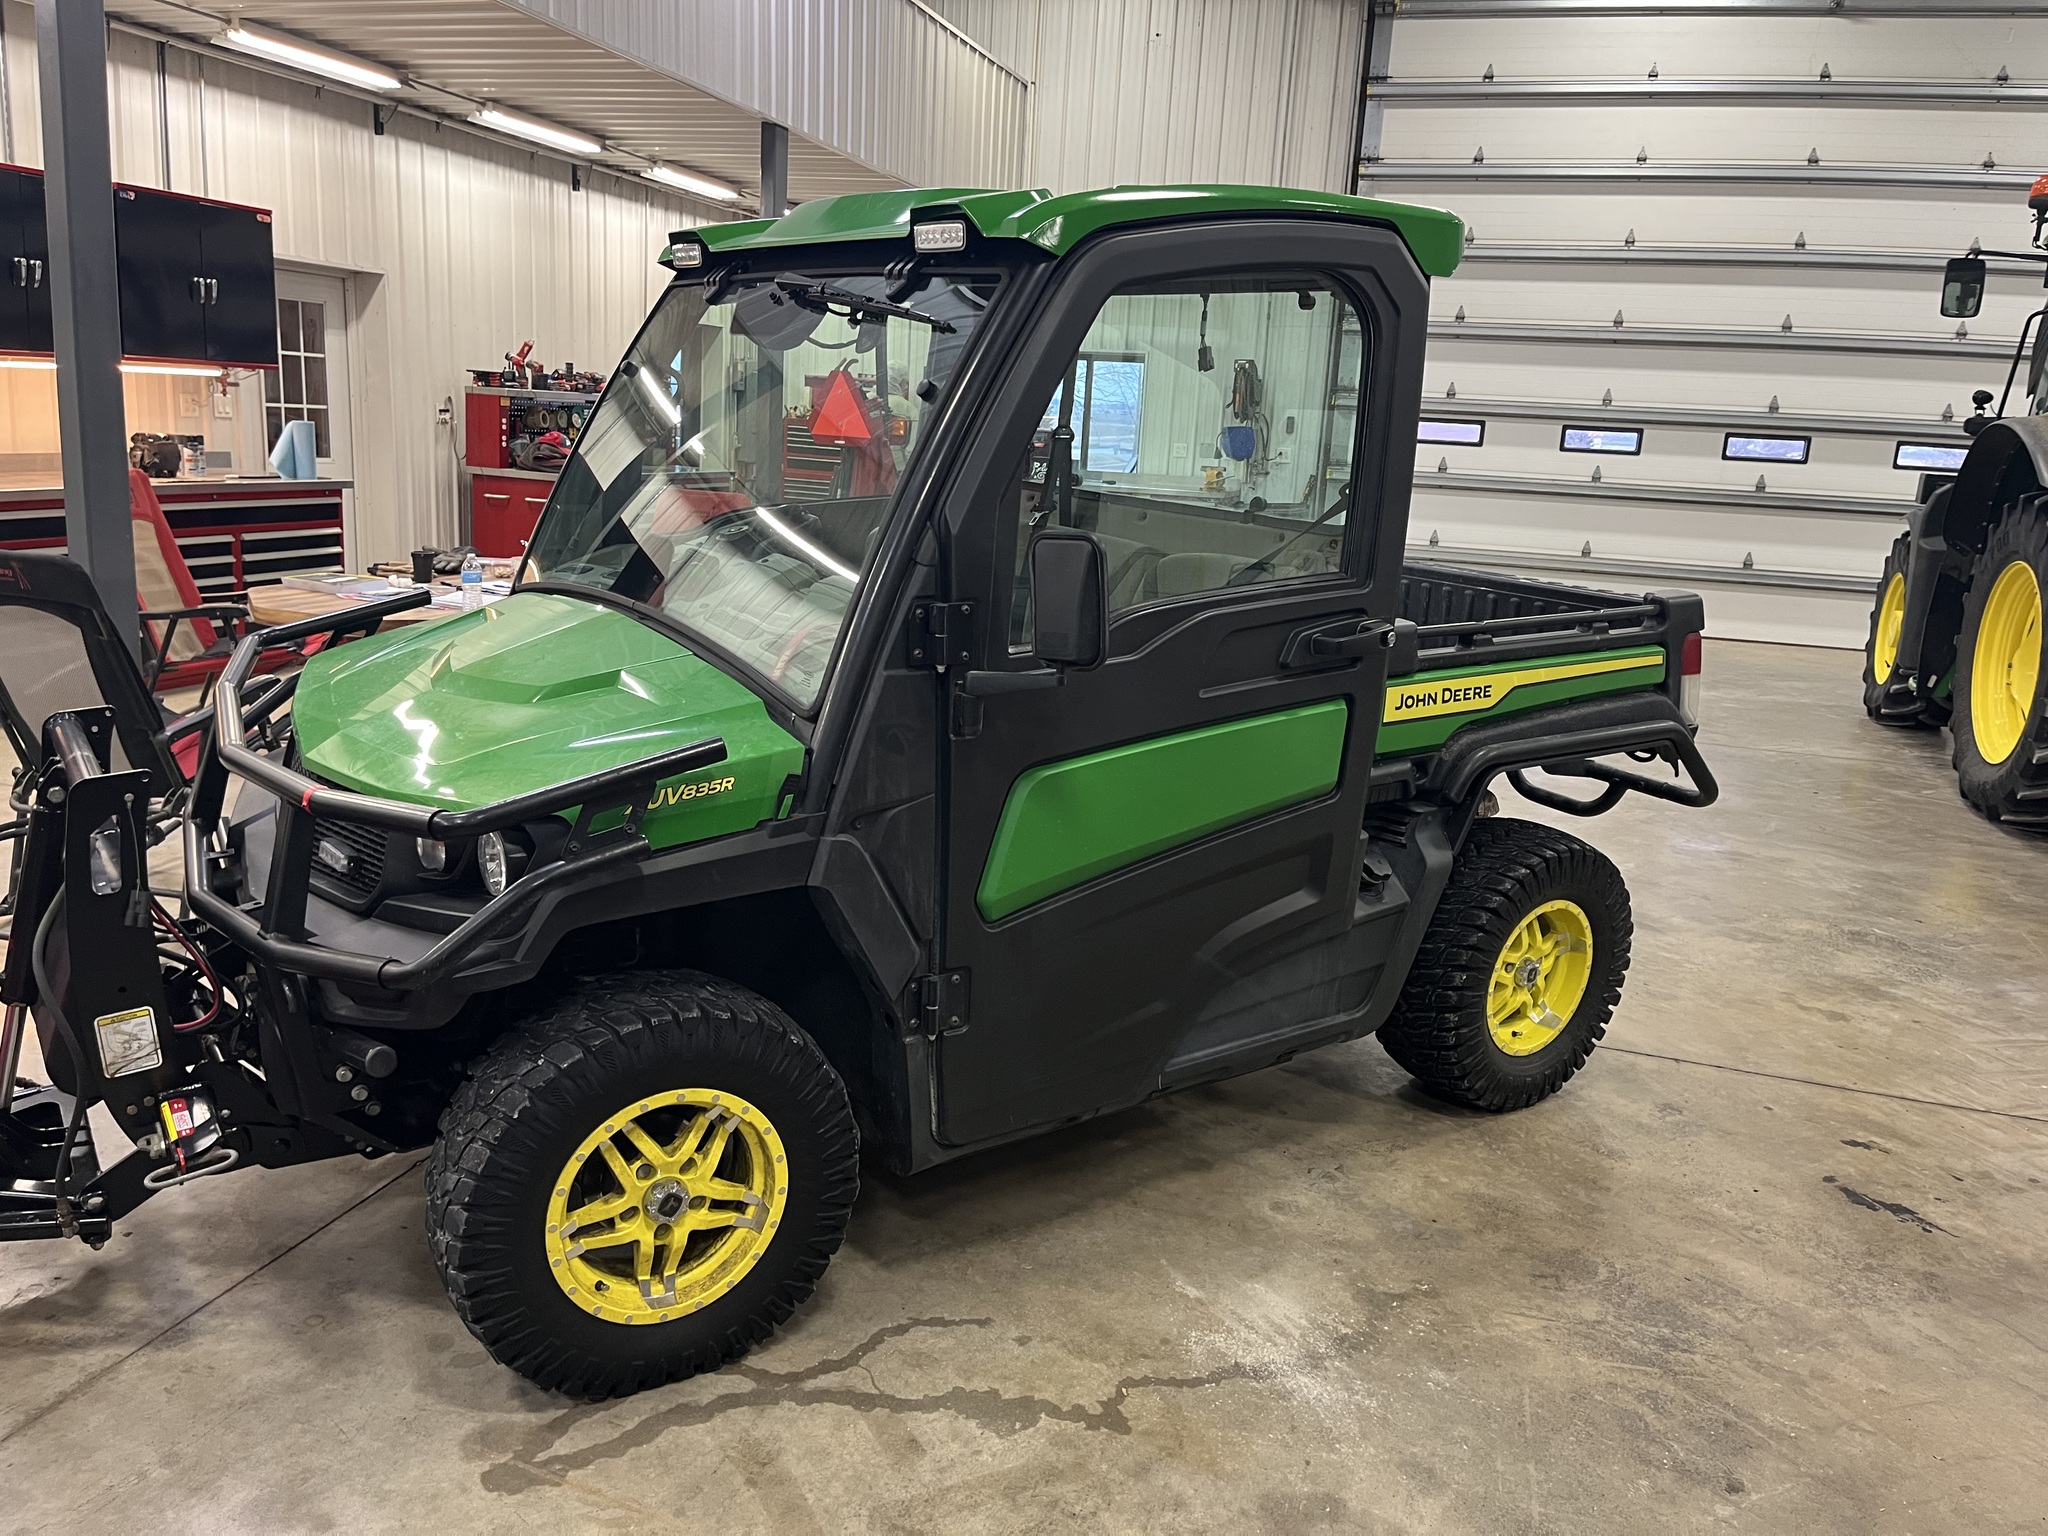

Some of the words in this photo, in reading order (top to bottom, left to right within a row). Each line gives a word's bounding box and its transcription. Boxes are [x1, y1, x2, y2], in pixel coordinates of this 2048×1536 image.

[1394, 691, 1438, 711] JOHN
[1441, 684, 1493, 704] DEERE
[622, 776, 736, 817] UV835R
